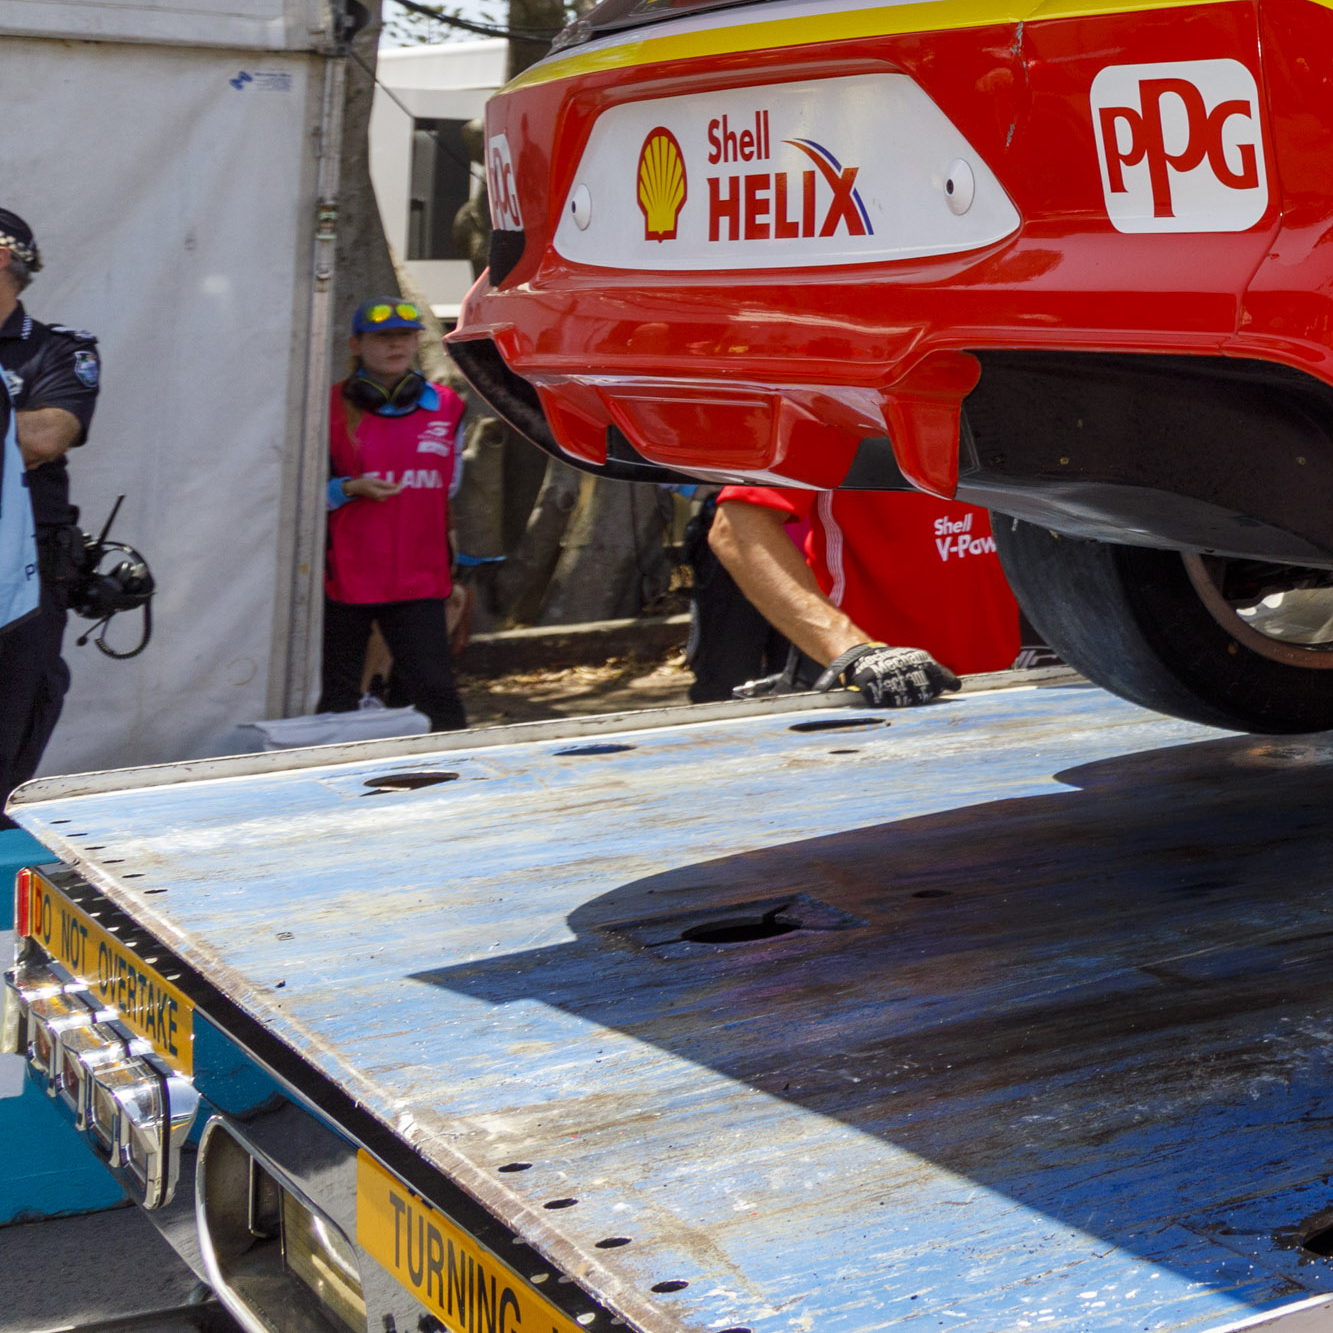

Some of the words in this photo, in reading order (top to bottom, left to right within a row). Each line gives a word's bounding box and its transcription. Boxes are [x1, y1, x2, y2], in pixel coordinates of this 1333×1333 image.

[708, 110, 771, 165] Shell
[706, 139, 874, 242] HELIX
[933, 513, 973, 536] Shell
[35, 886, 51, 945] DO
[61, 909, 88, 976] NOT
[98, 941, 178, 1059] OVERTAKE
